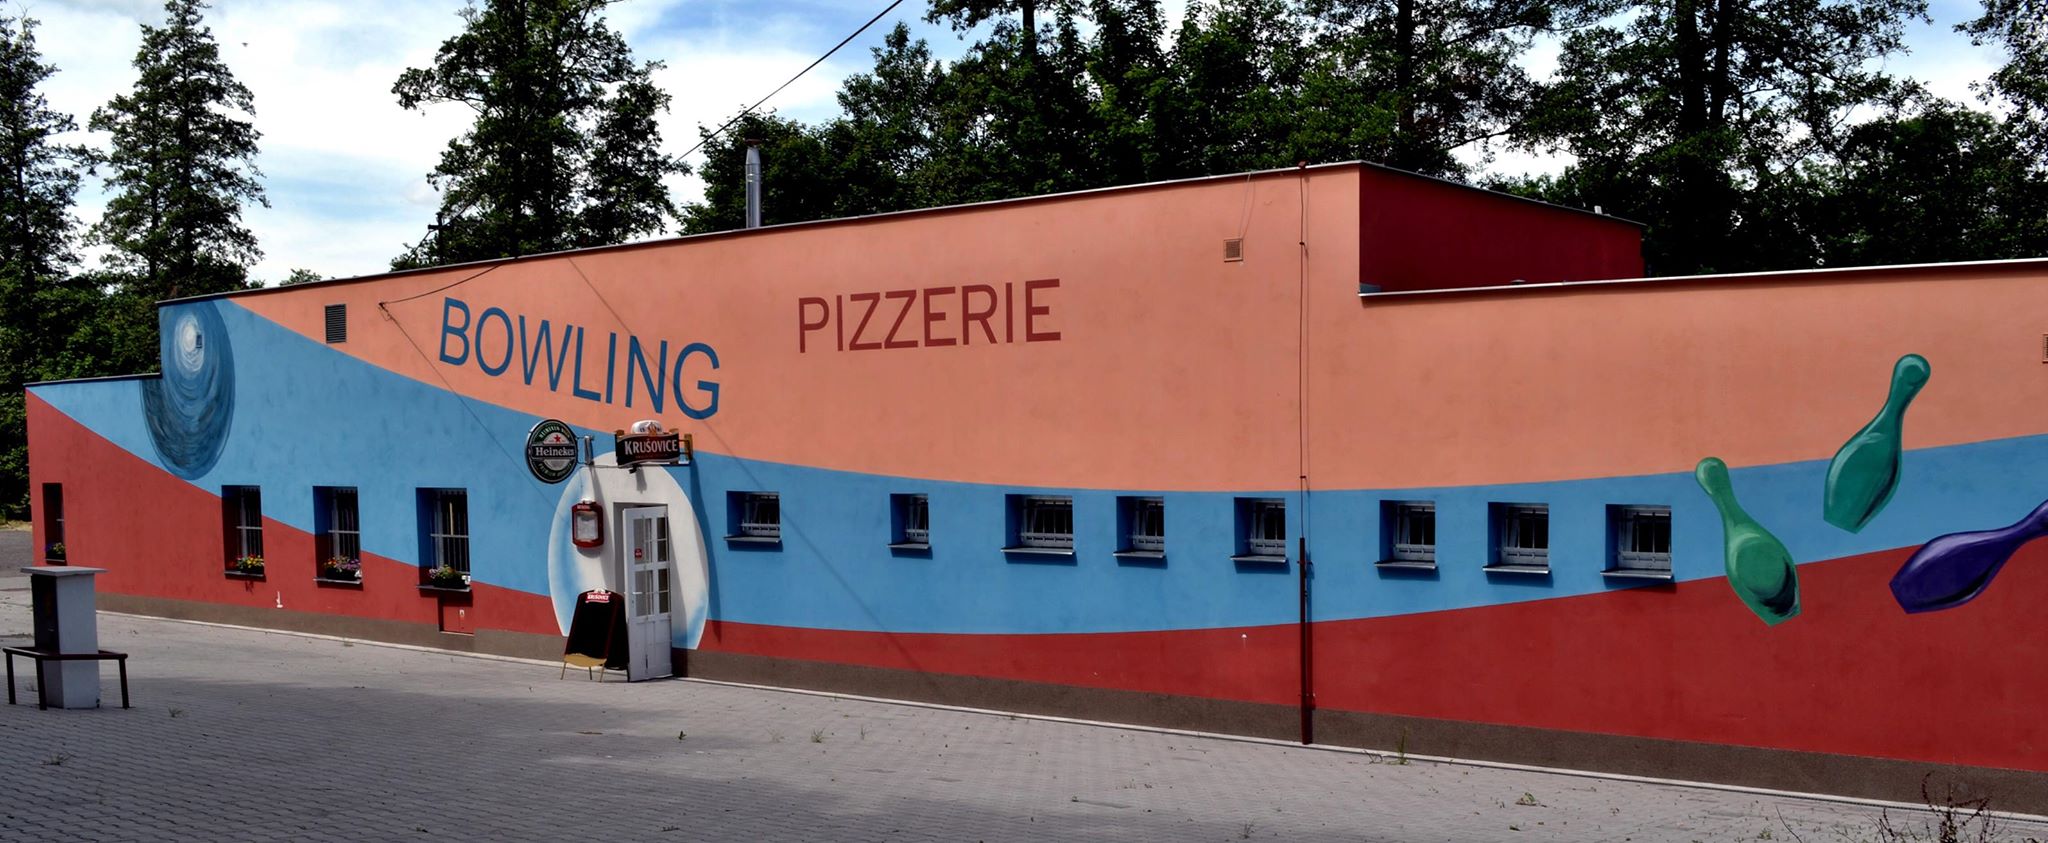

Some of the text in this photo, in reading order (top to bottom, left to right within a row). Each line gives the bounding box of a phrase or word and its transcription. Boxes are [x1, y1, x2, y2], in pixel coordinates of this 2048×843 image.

[799, 279, 1061, 353] PIZZERIE
[439, 297, 720, 420] BOWLING
[535, 446, 575, 456] Heineken
[624, 439, 678, 455] KRUŠOVICE
